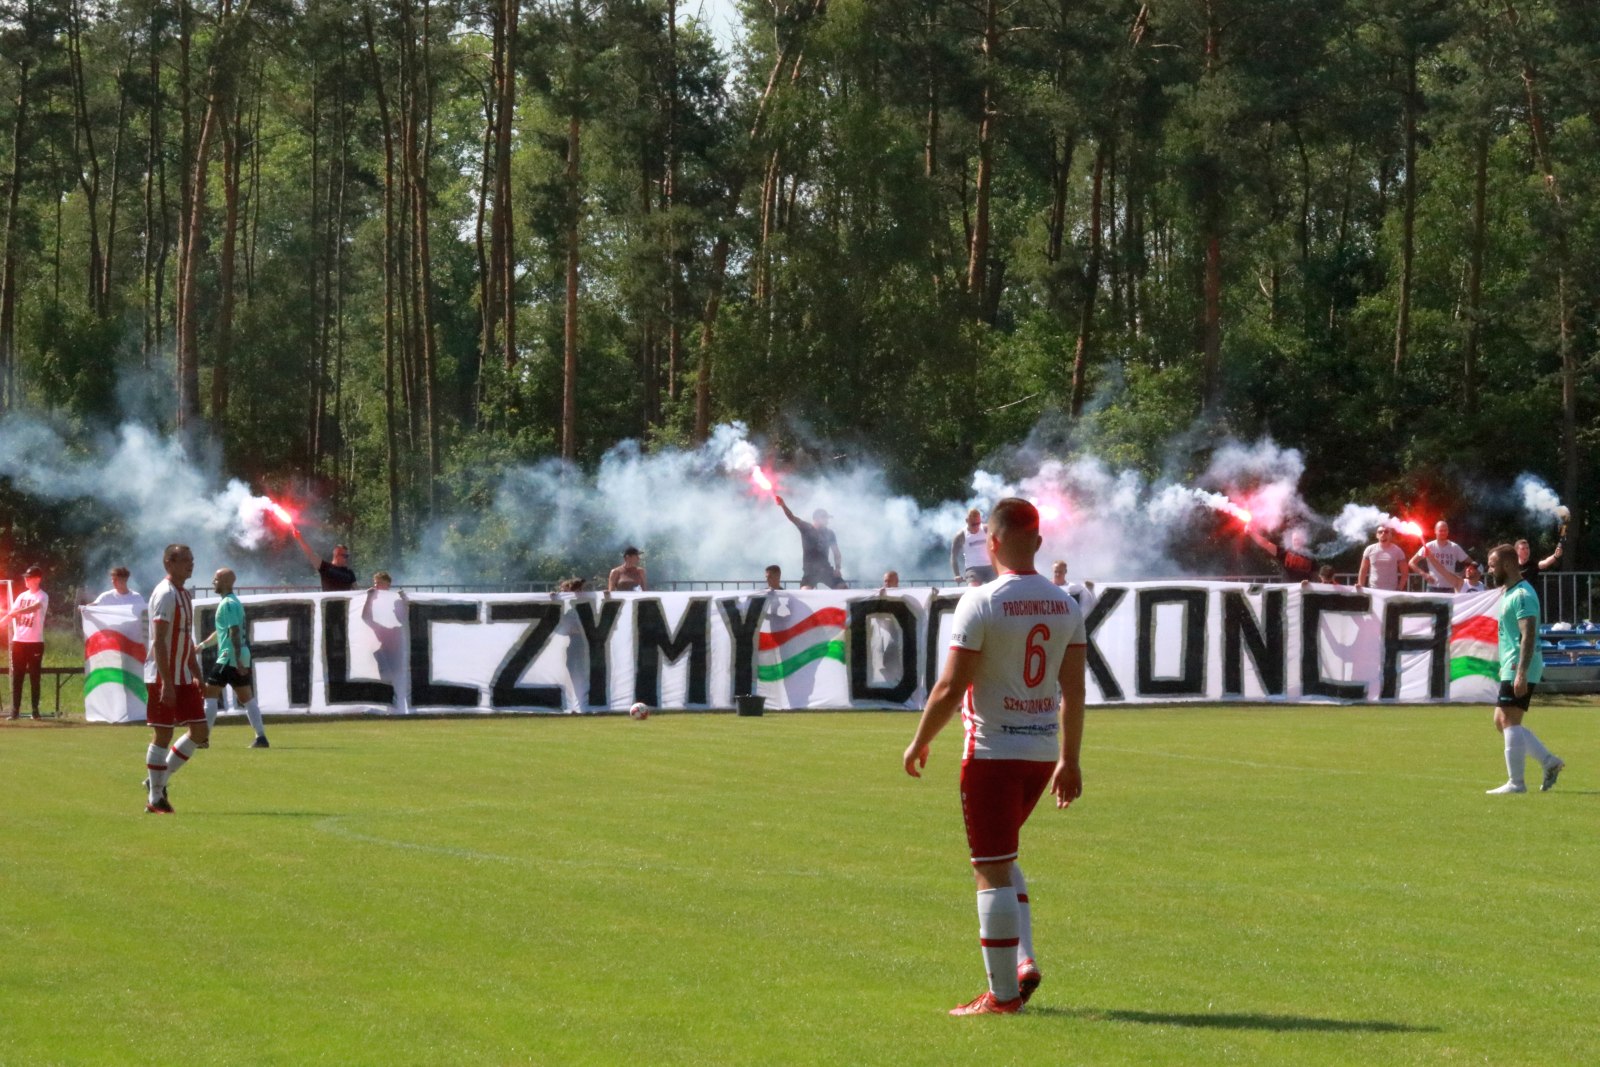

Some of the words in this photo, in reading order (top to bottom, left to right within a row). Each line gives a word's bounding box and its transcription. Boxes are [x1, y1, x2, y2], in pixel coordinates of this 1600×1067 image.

[1003, 599, 1070, 617] PROCHOWICZANKA
[1023, 623, 1050, 688] 6
[1072, 583, 1452, 700] KOŃCA
